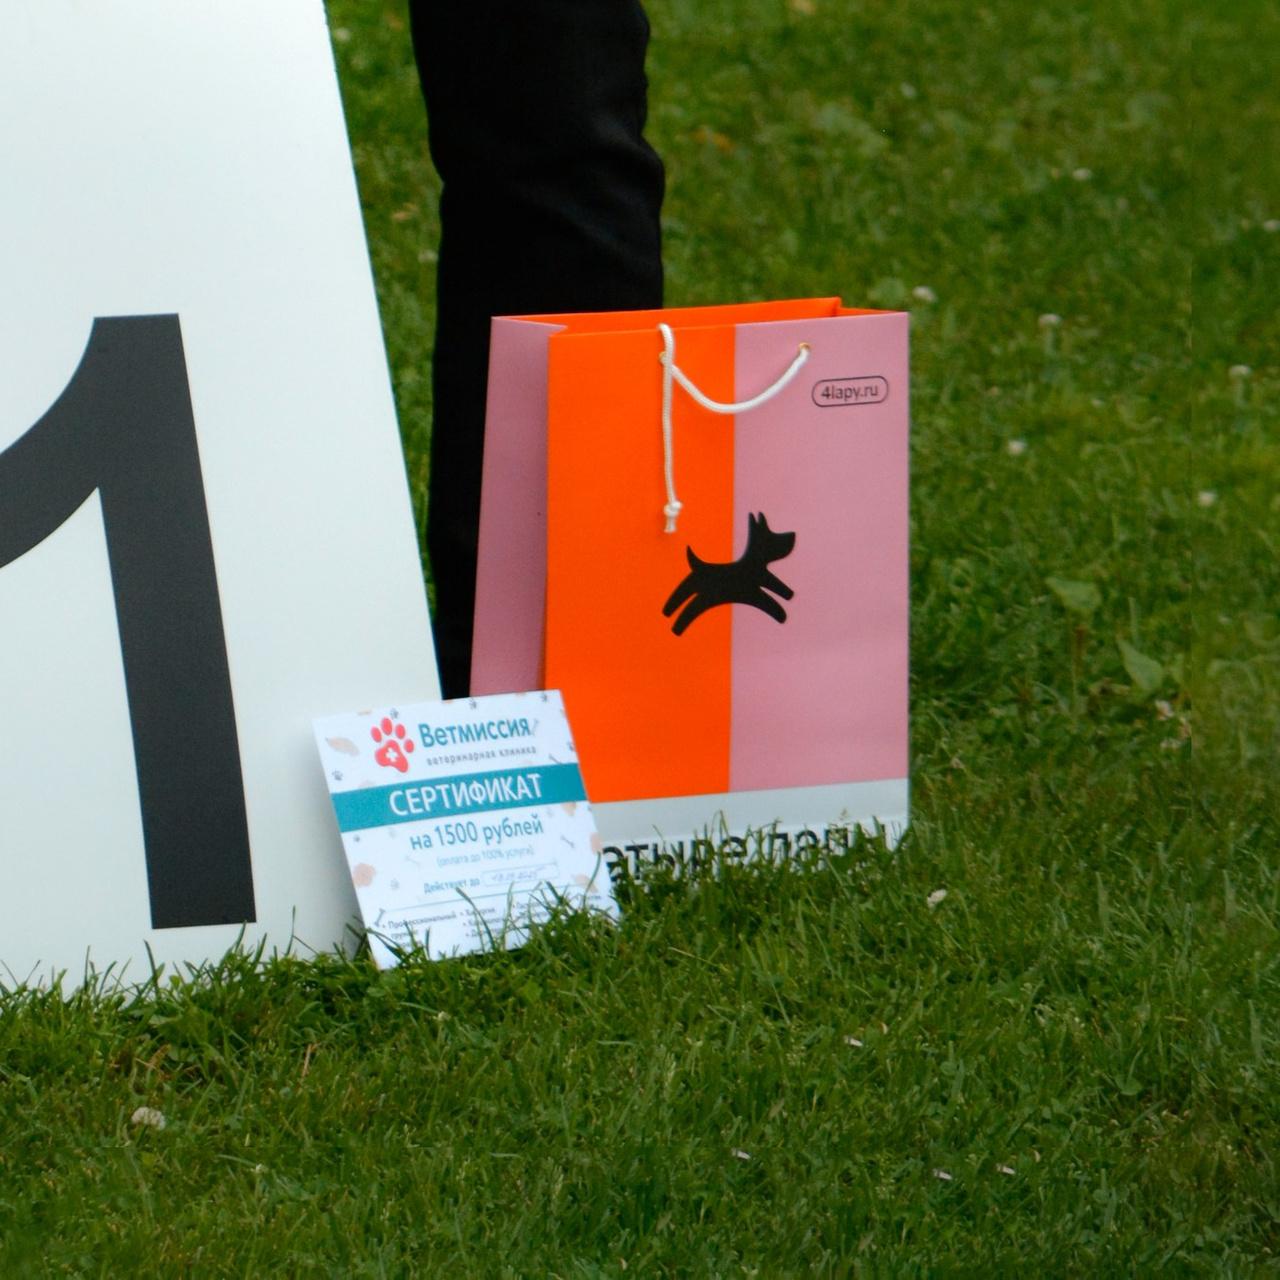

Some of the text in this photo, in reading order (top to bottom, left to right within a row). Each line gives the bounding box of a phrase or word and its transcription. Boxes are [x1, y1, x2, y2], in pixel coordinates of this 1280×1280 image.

[821, 384, 879, 401] 4lapy.ru
[417, 717, 532, 748] Ветмиссия
[426, 745, 537, 766] ветеринарная клиника
[388, 773, 544, 817] СЕРТИФИКАТ
[410, 814, 545, 851] на 1500 рублей
